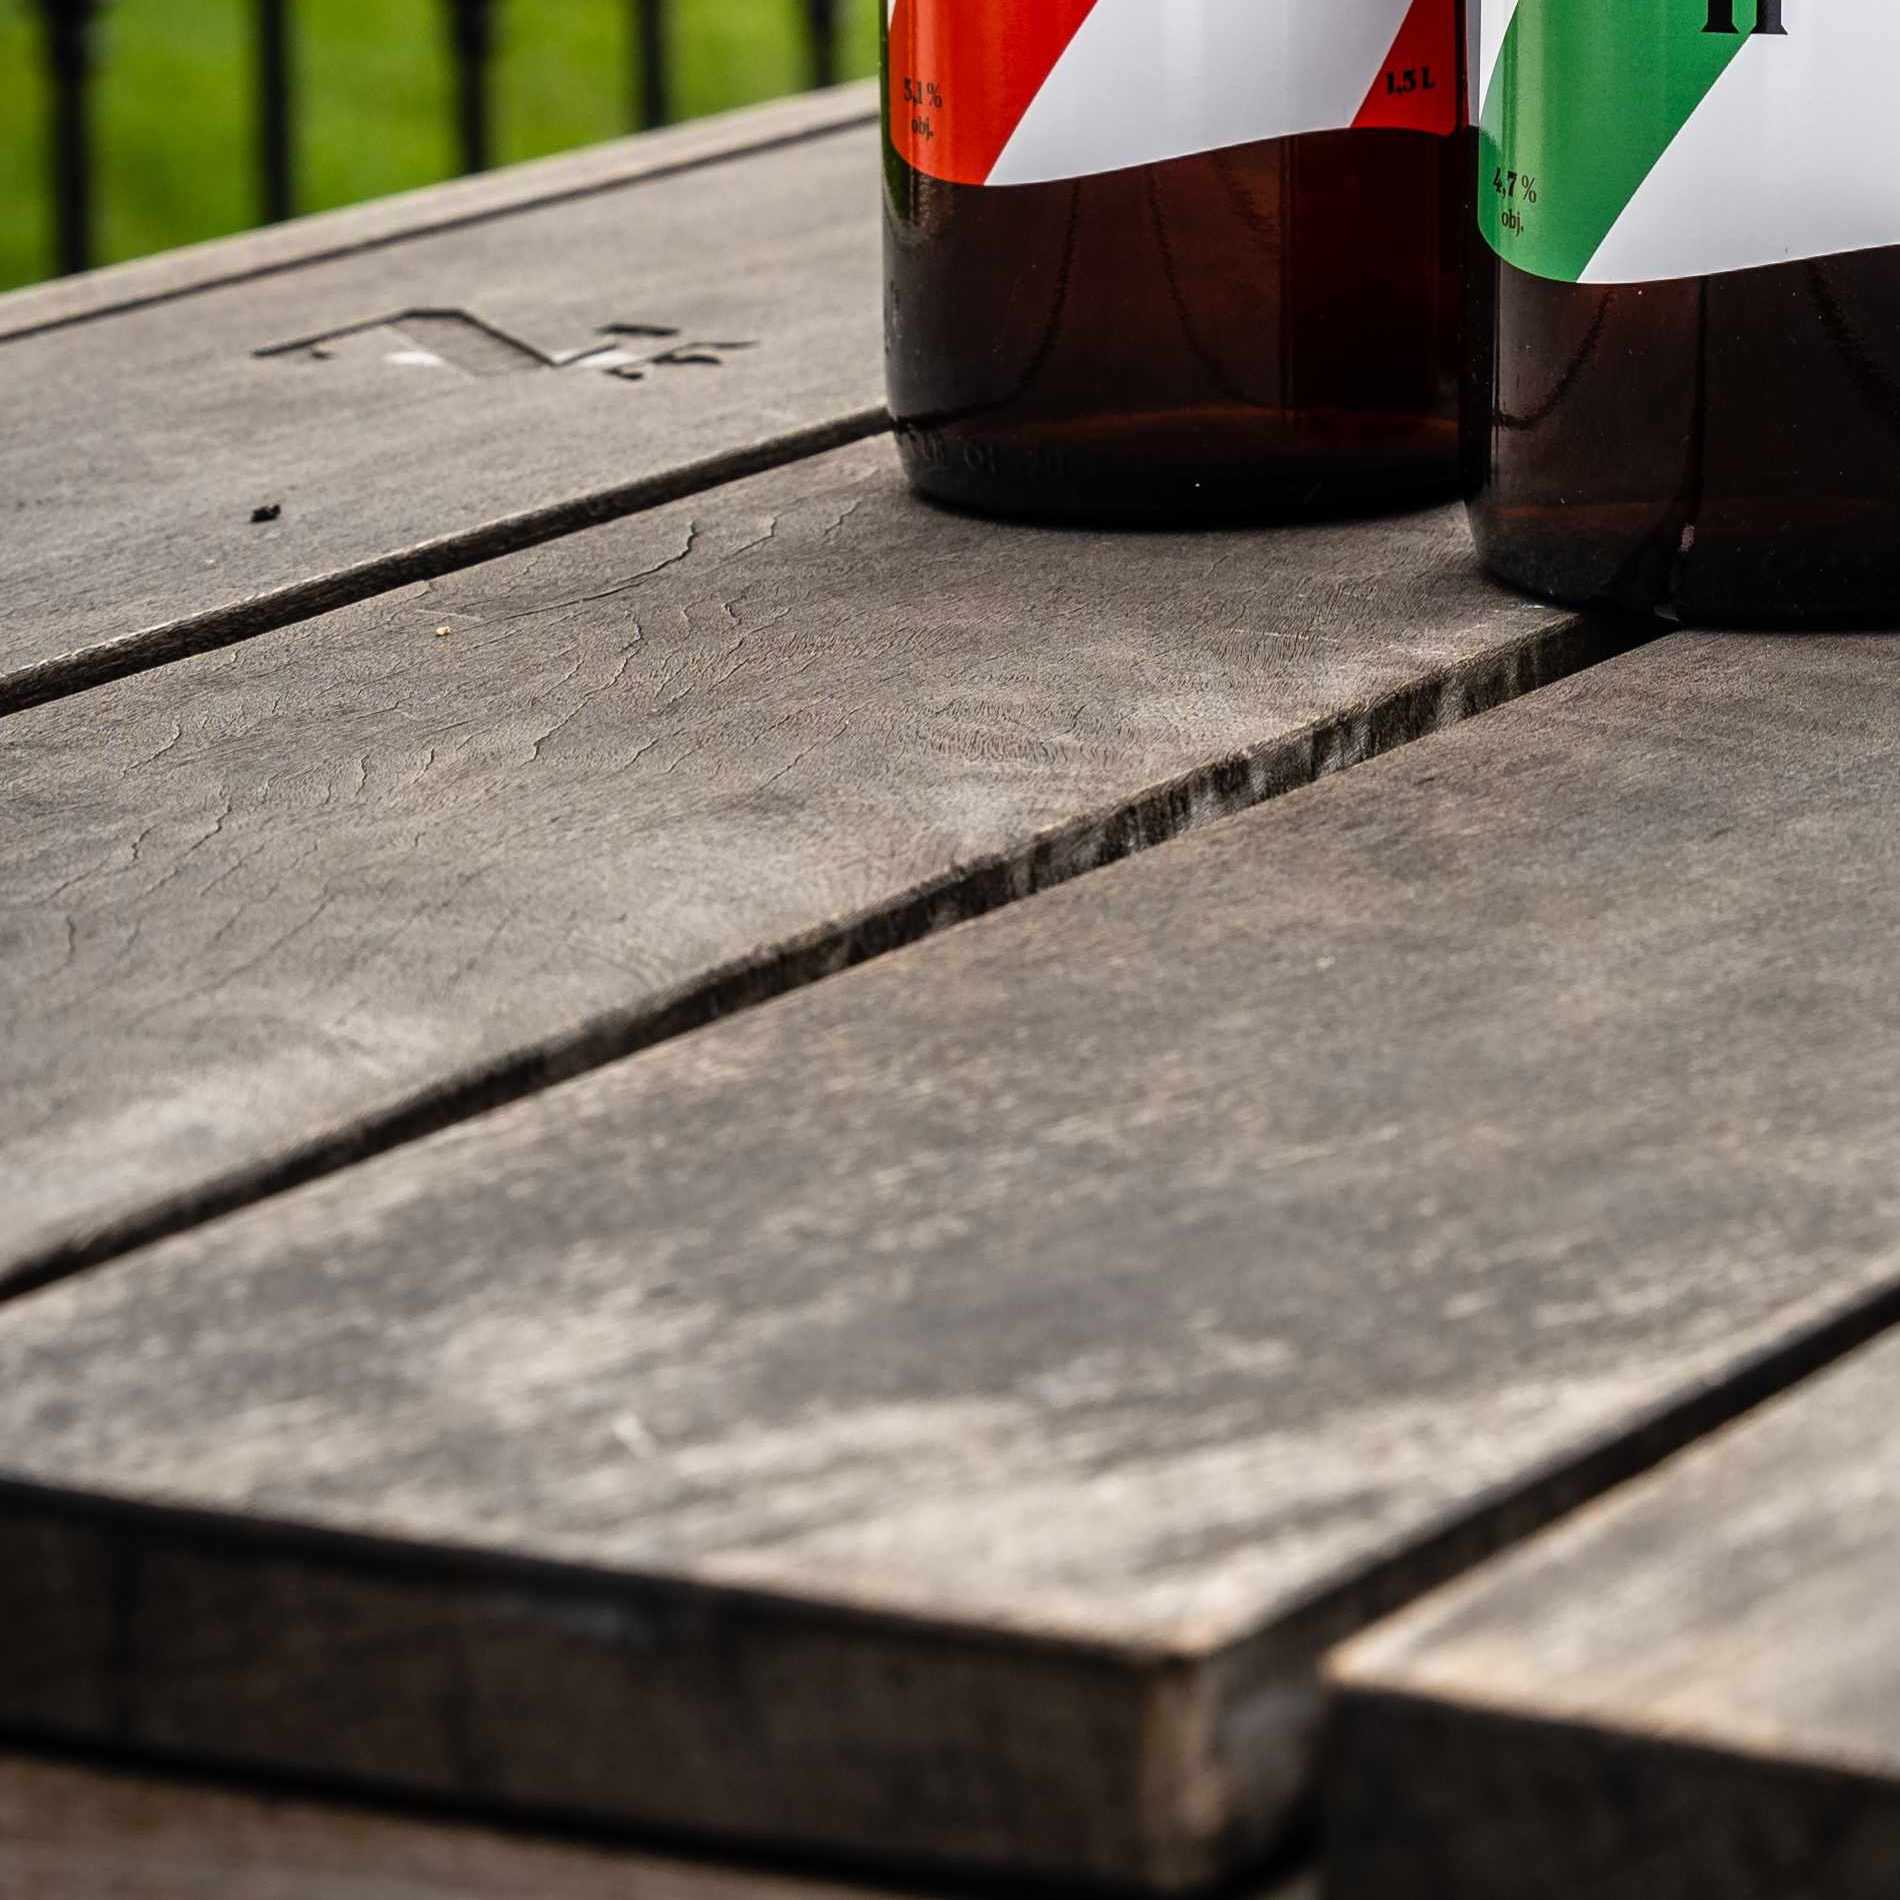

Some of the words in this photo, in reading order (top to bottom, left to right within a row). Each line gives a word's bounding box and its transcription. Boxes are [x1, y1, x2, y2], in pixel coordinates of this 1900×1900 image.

[1386, 69, 1417, 96] 1,5
[1421, 67, 1436, 90] L
[1493, 167, 1518, 200] 4,7
[1521, 174, 1537, 203] %
[1501, 208, 1524, 237] obj.
